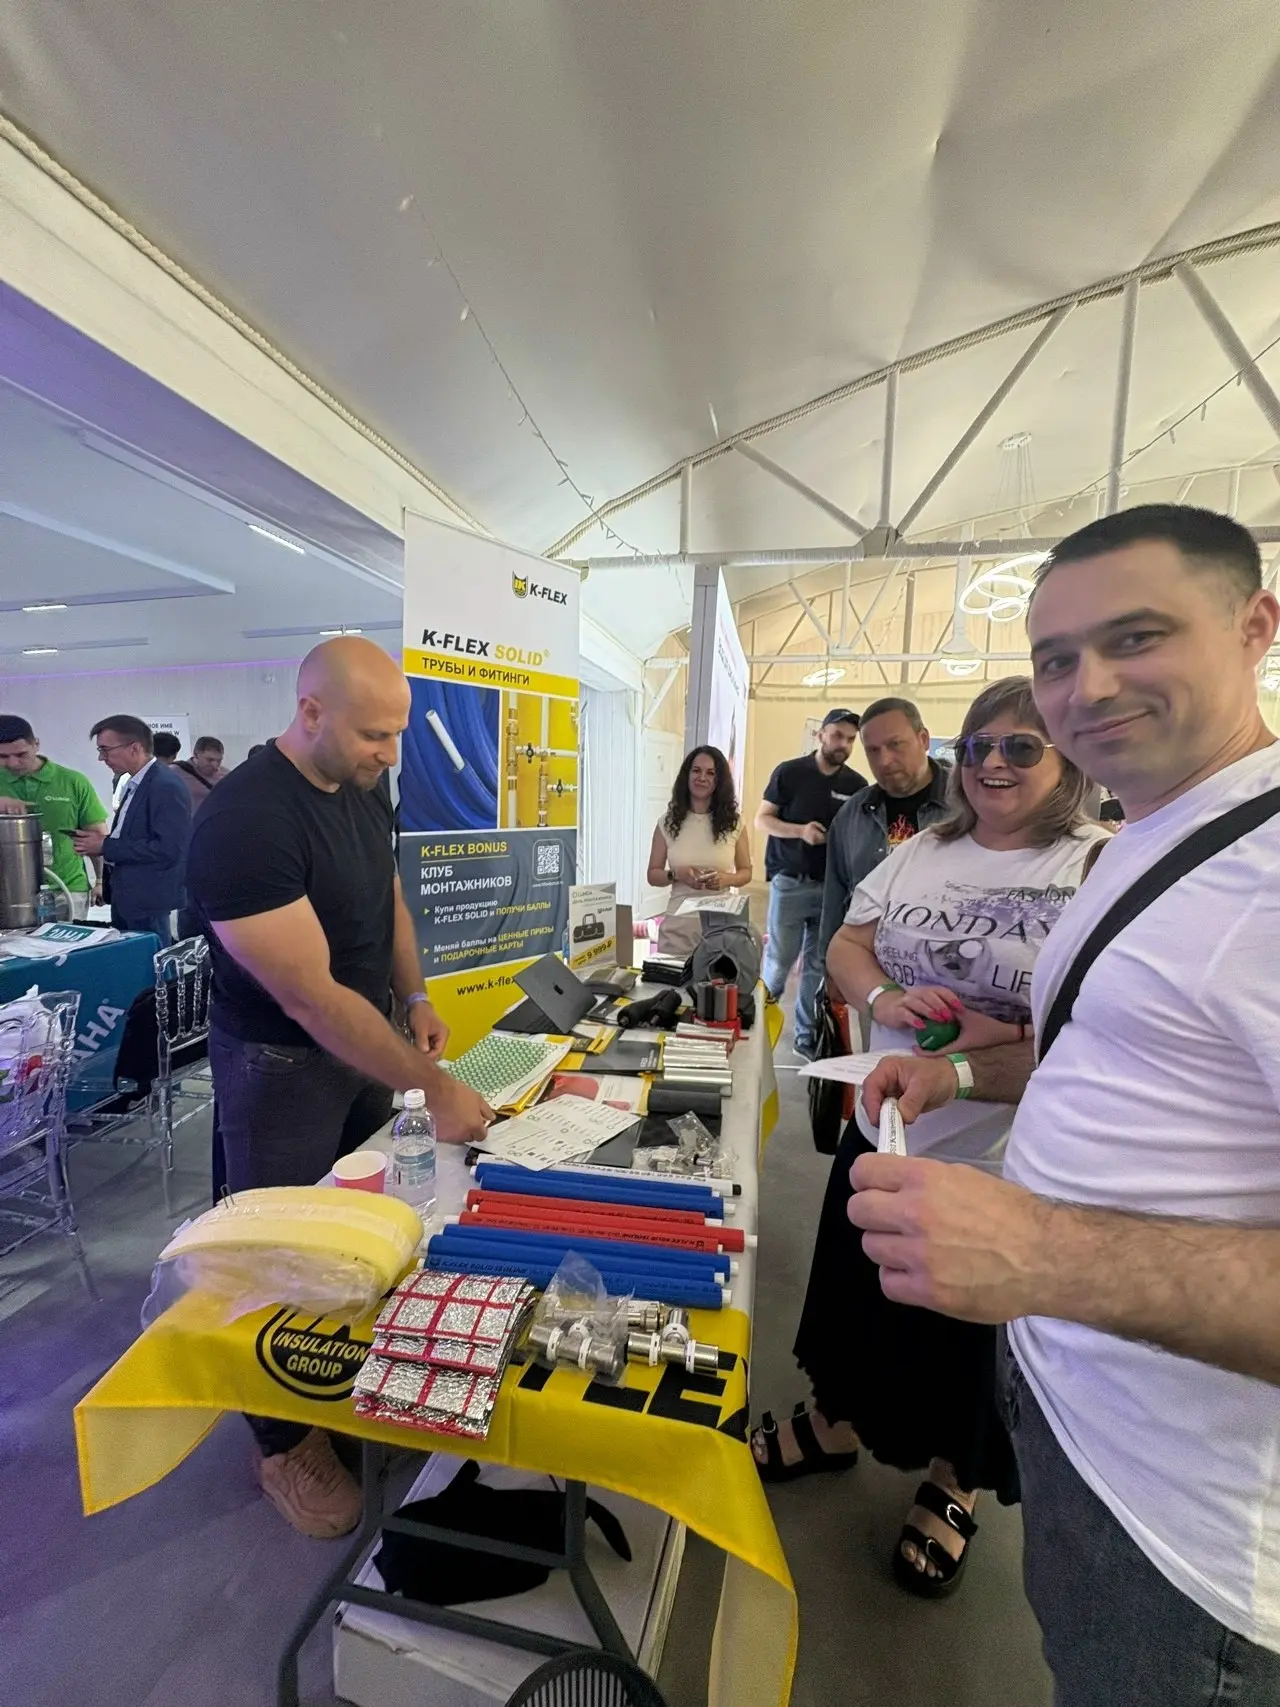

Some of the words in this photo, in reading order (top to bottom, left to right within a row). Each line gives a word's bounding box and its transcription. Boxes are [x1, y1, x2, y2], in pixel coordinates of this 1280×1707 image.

[530, 583, 568, 606] K-FLEX
[421, 629, 490, 657] K-FLEX
[421, 657, 465, 675] ТРУБЫ
[468, 665, 476, 678] И
[479, 667, 530, 686] ФИТИНГИ
[421, 843, 465, 858] K-FLEX
[467, 841, 508, 855] BONUS
[421, 865, 454, 880] КЛУБ
[421, 875, 513, 896] МОНТАЖНИКОВ
[434, 905, 454, 915] Купи
[455, 900, 498, 911] продукцию
[434, 914, 463, 925] K-FLEX
[464, 909, 488, 920] SOLID
[495, 904, 526, 915] ПОЛУЧИ
[526, 901, 552, 911] БАЛЛЫ
[433, 943, 460, 953] Меняй
[461, 938, 487, 948] баллы
[487, 936, 497, 944] на
[497, 930, 529, 941] ЦЕННЫЕ
[529, 926, 554, 936] ПРИЗЫ
[440, 945, 498, 962] ПОДАРОЧНЫЕ
[498, 940, 524, 952] КАРТЫ
[272, 1331, 371, 1362] INSULATION
[286, 1354, 342, 1379] GROUP
